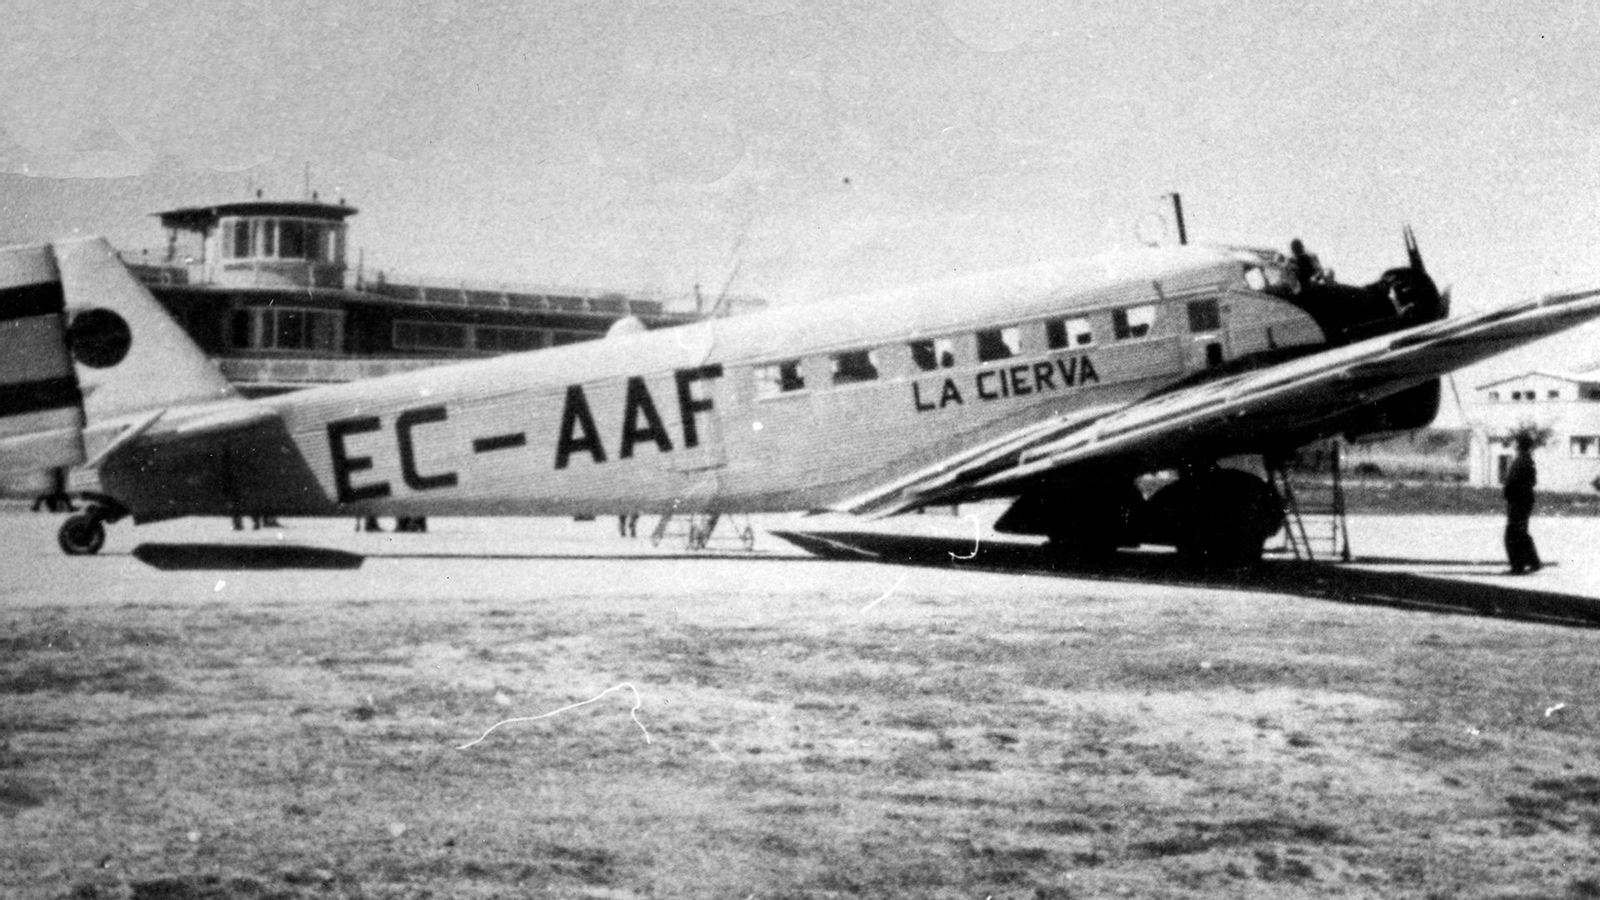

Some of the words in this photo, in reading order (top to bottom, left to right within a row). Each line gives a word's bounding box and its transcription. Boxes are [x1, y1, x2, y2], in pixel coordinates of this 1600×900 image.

[912, 378, 963, 412] LA
[976, 355, 1099, 401] CIERVA
[327, 363, 724, 503] EC-AAF
